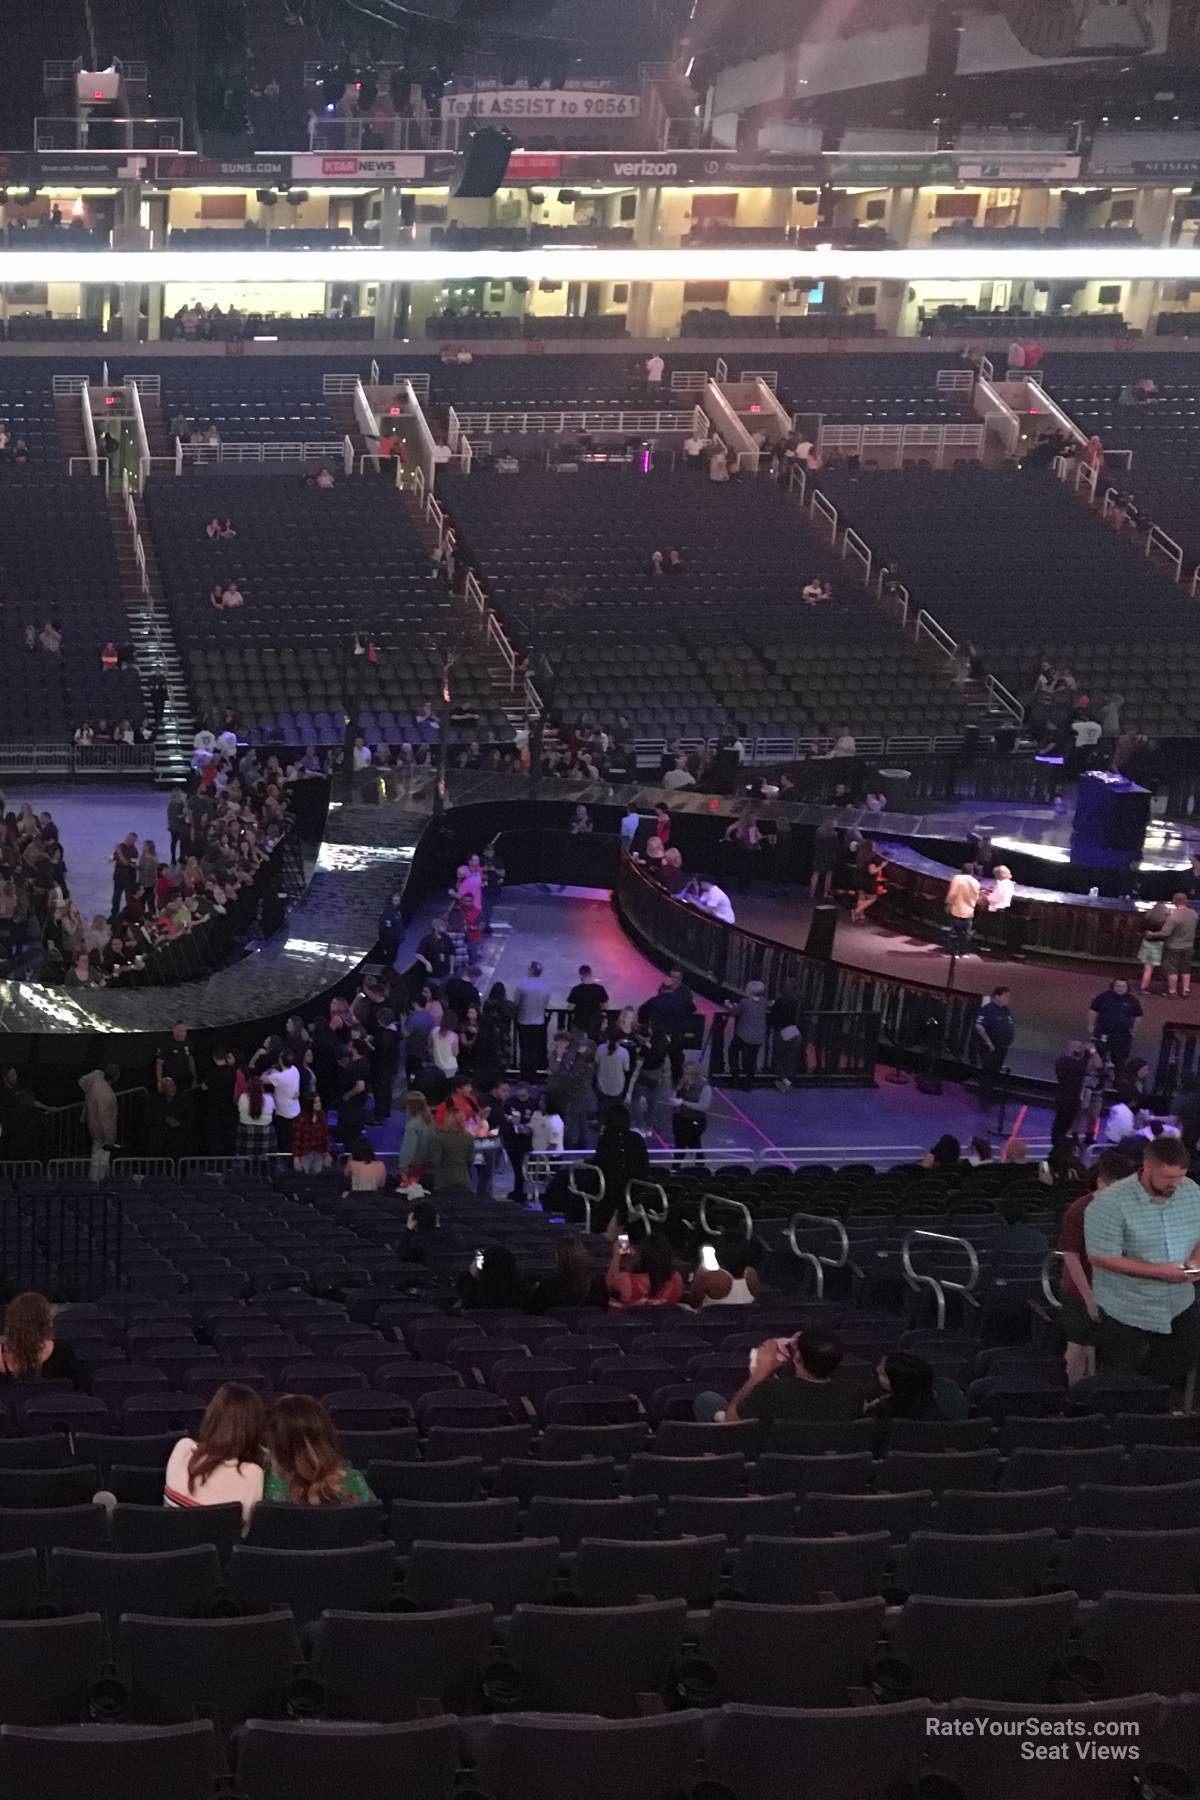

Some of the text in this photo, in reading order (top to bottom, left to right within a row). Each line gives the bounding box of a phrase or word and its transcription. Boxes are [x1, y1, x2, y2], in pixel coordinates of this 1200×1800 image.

[447, 98, 637, 115] Text ASSIST to 90561
[323, 160, 397, 173] KTAR NEWS
[612, 159, 678, 177] verizon
